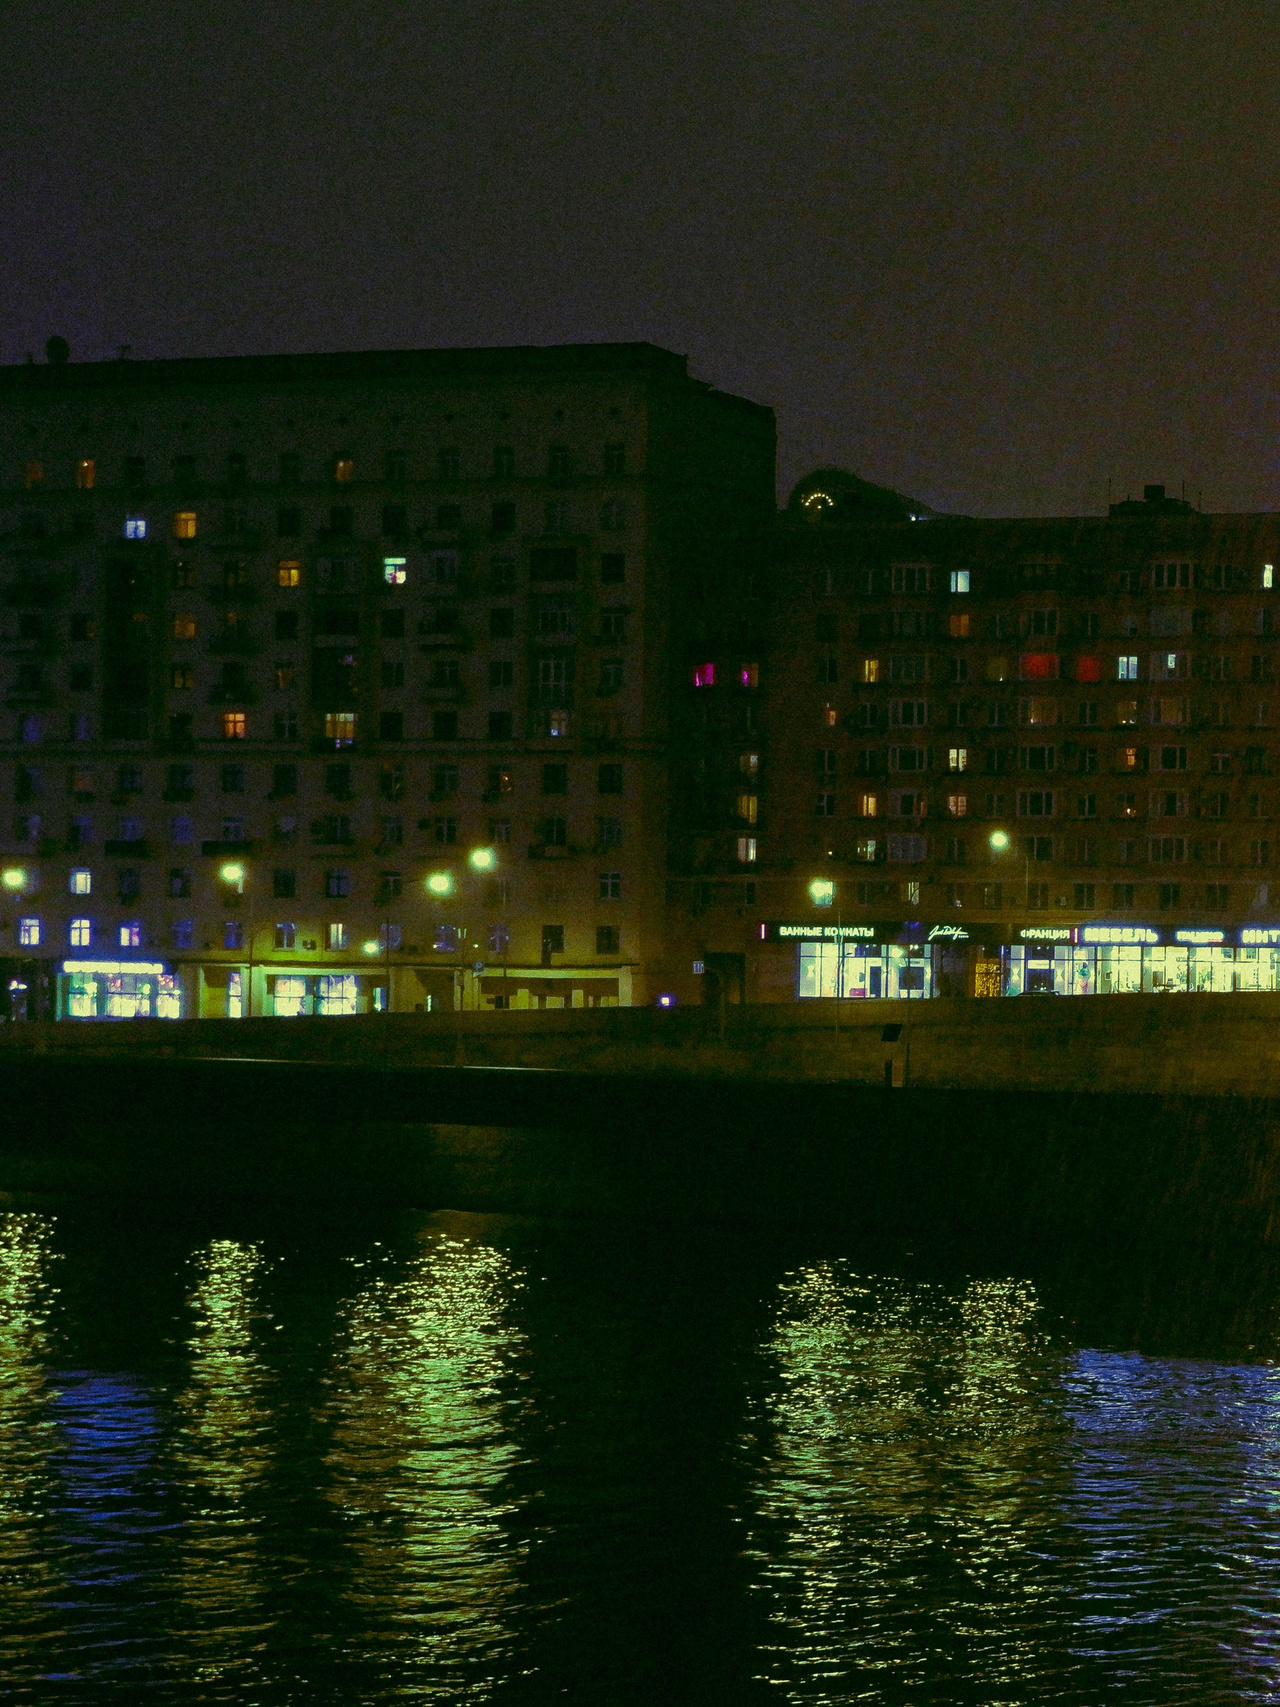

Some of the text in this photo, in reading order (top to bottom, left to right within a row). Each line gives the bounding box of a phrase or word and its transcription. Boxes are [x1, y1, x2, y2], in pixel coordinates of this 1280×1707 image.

[780, 926, 822, 936] ВАННЫЕ
[1020, 928, 1070, 940] ФРАНЦИЯ
[1084, 927, 1158, 943] МЕБЕЛЬ
